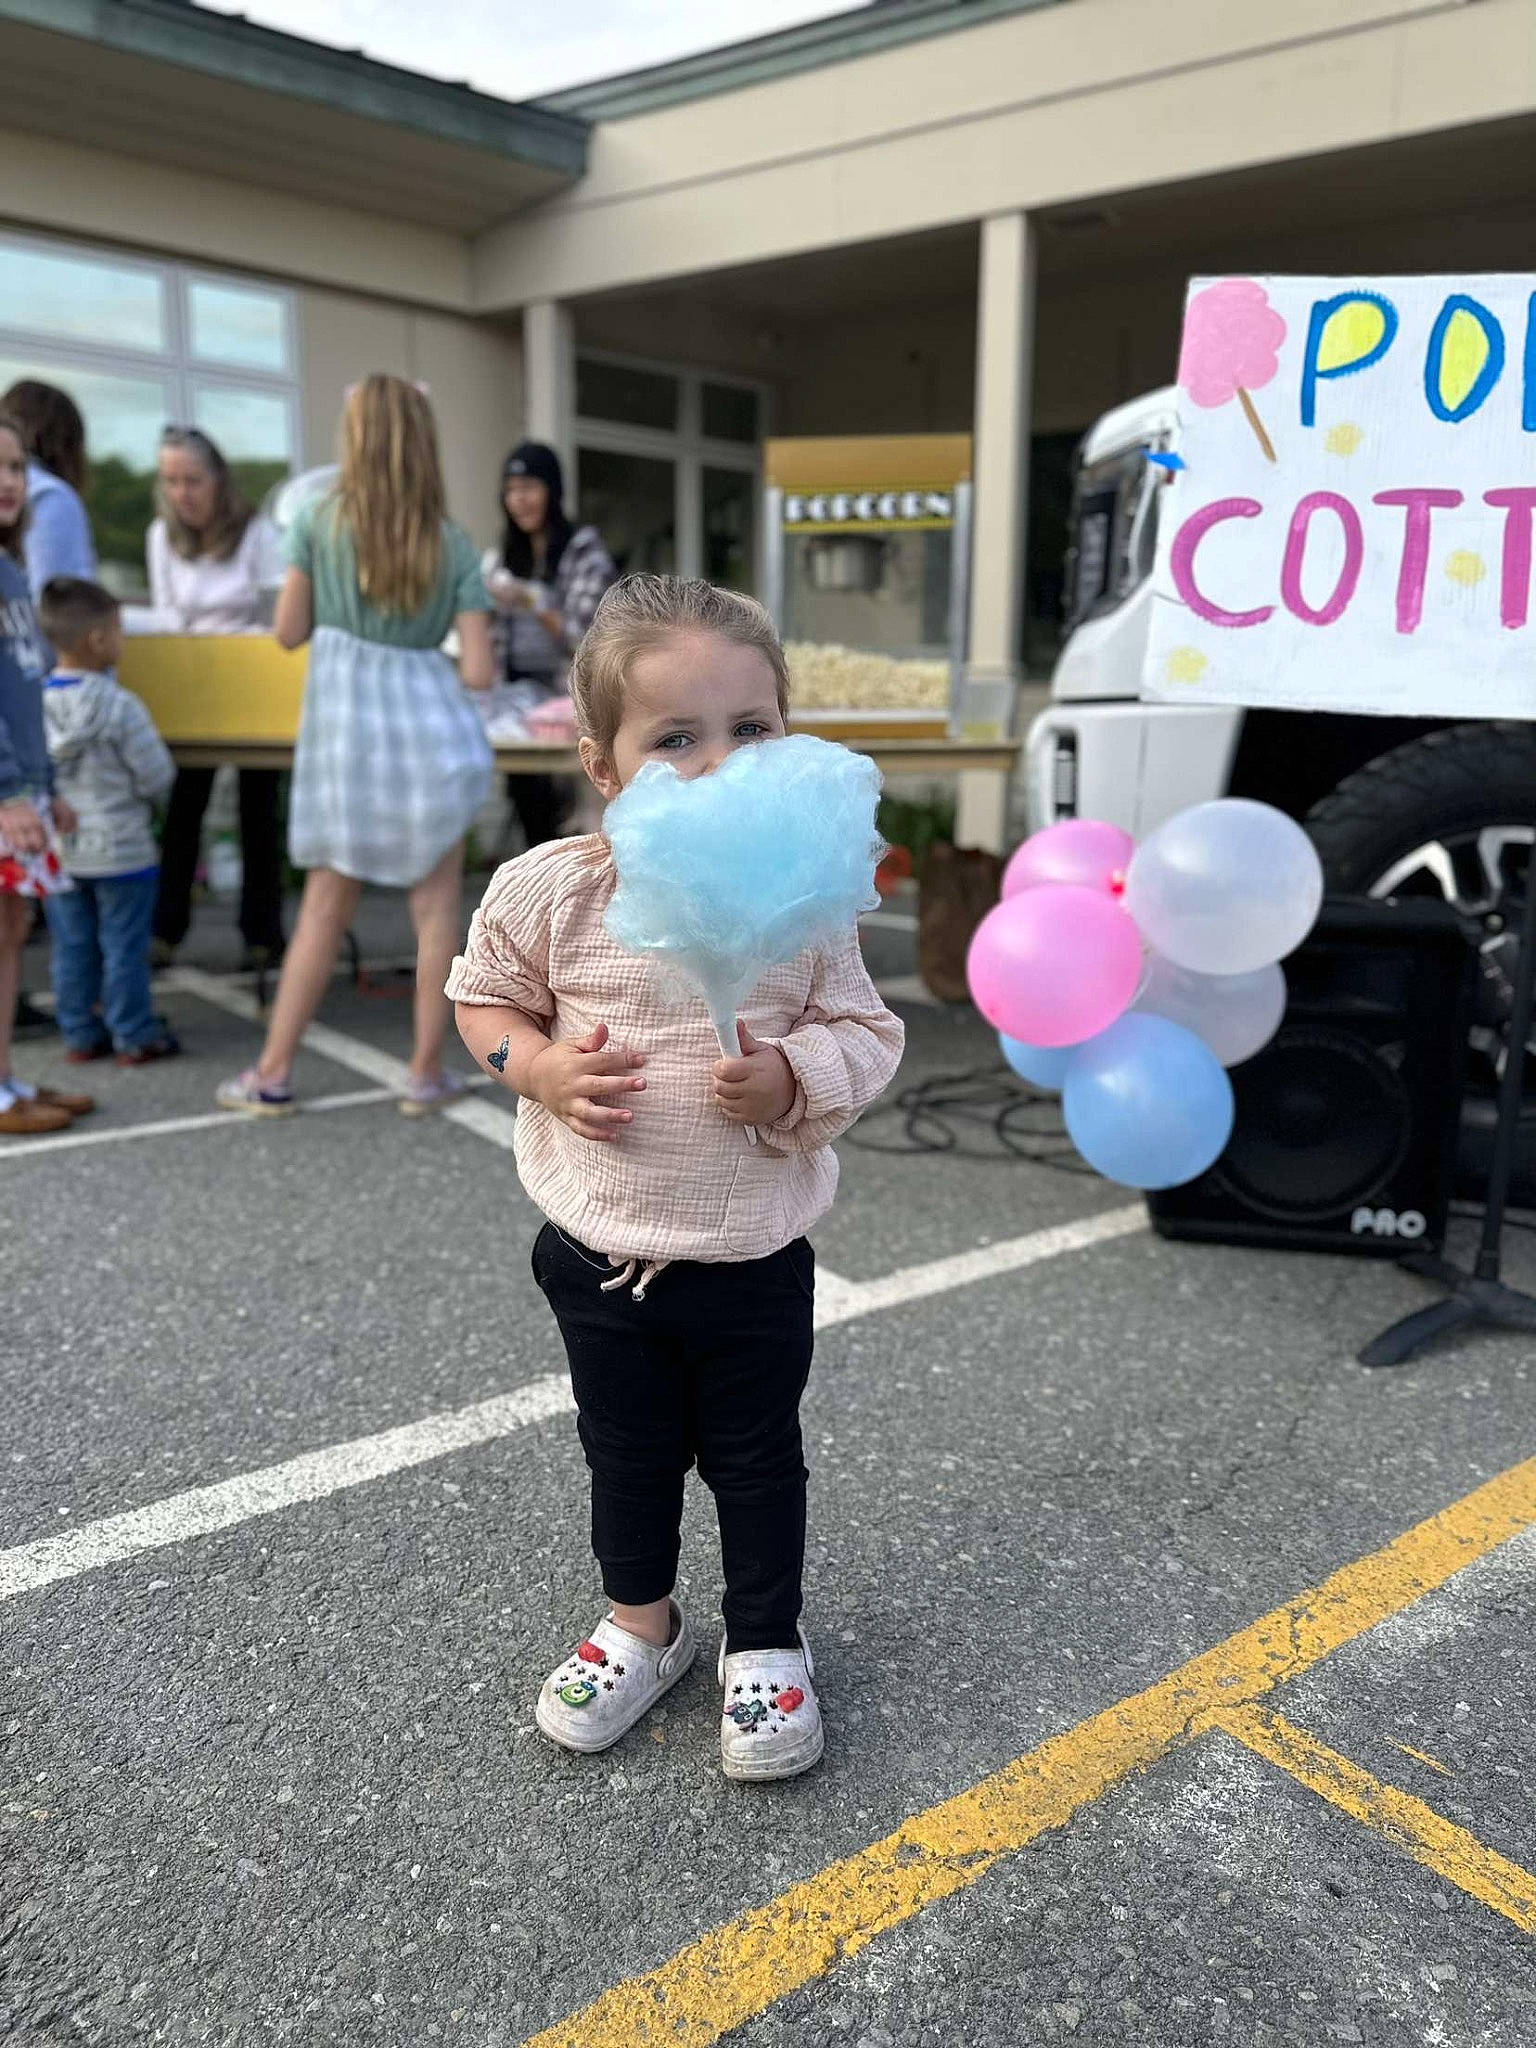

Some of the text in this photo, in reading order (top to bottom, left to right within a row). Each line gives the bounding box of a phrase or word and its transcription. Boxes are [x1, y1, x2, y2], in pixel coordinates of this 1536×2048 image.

[1300, 289, 1536, 432] PO
[1170, 487, 1536, 634] COTT
[1350, 1206, 1427, 1239] PRO
